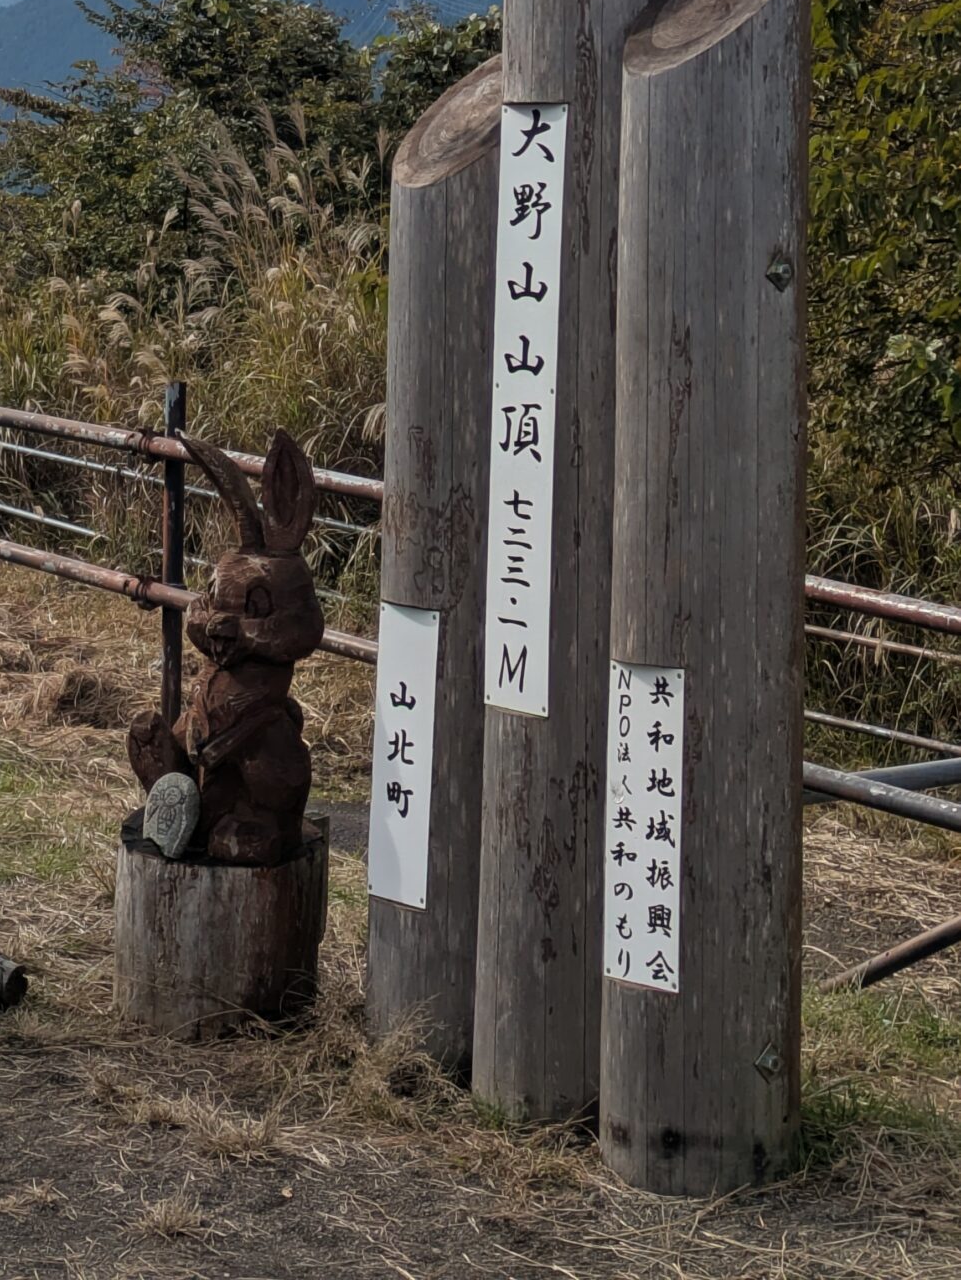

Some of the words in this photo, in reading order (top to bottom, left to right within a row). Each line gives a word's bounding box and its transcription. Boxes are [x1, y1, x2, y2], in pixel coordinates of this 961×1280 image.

[498, 107, 556, 463] 大野山山頂
[386, 680, 417, 819] 山北町
[645, 675, 676, 983] 共和地域振興会
